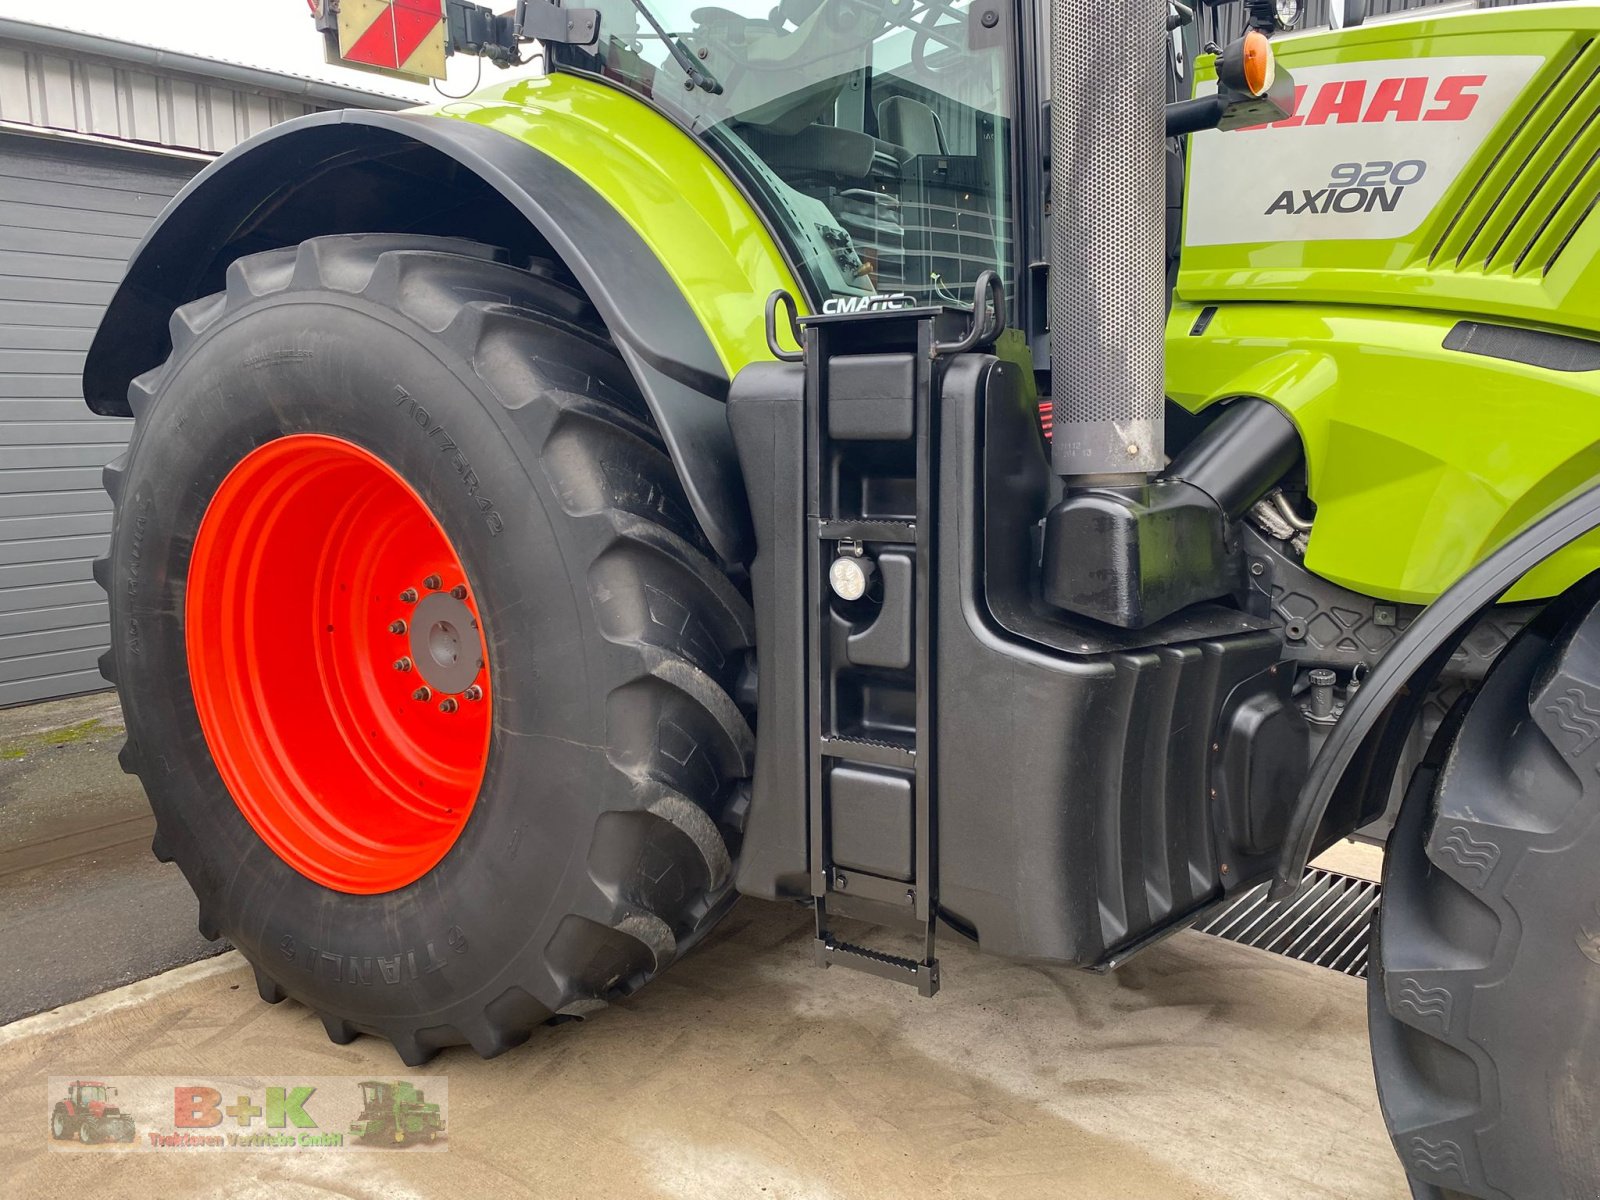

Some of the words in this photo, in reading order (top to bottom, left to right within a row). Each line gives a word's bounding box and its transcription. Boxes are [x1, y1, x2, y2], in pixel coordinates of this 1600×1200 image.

[1235, 75, 1487, 131] LAAS
[1328, 160, 1427, 189] 920
[1264, 186, 1404, 215] AXION
[822, 293, 905, 315] CMATIC
[394, 384, 504, 537] 710/75R42
[304, 938, 449, 985] TIANLI
